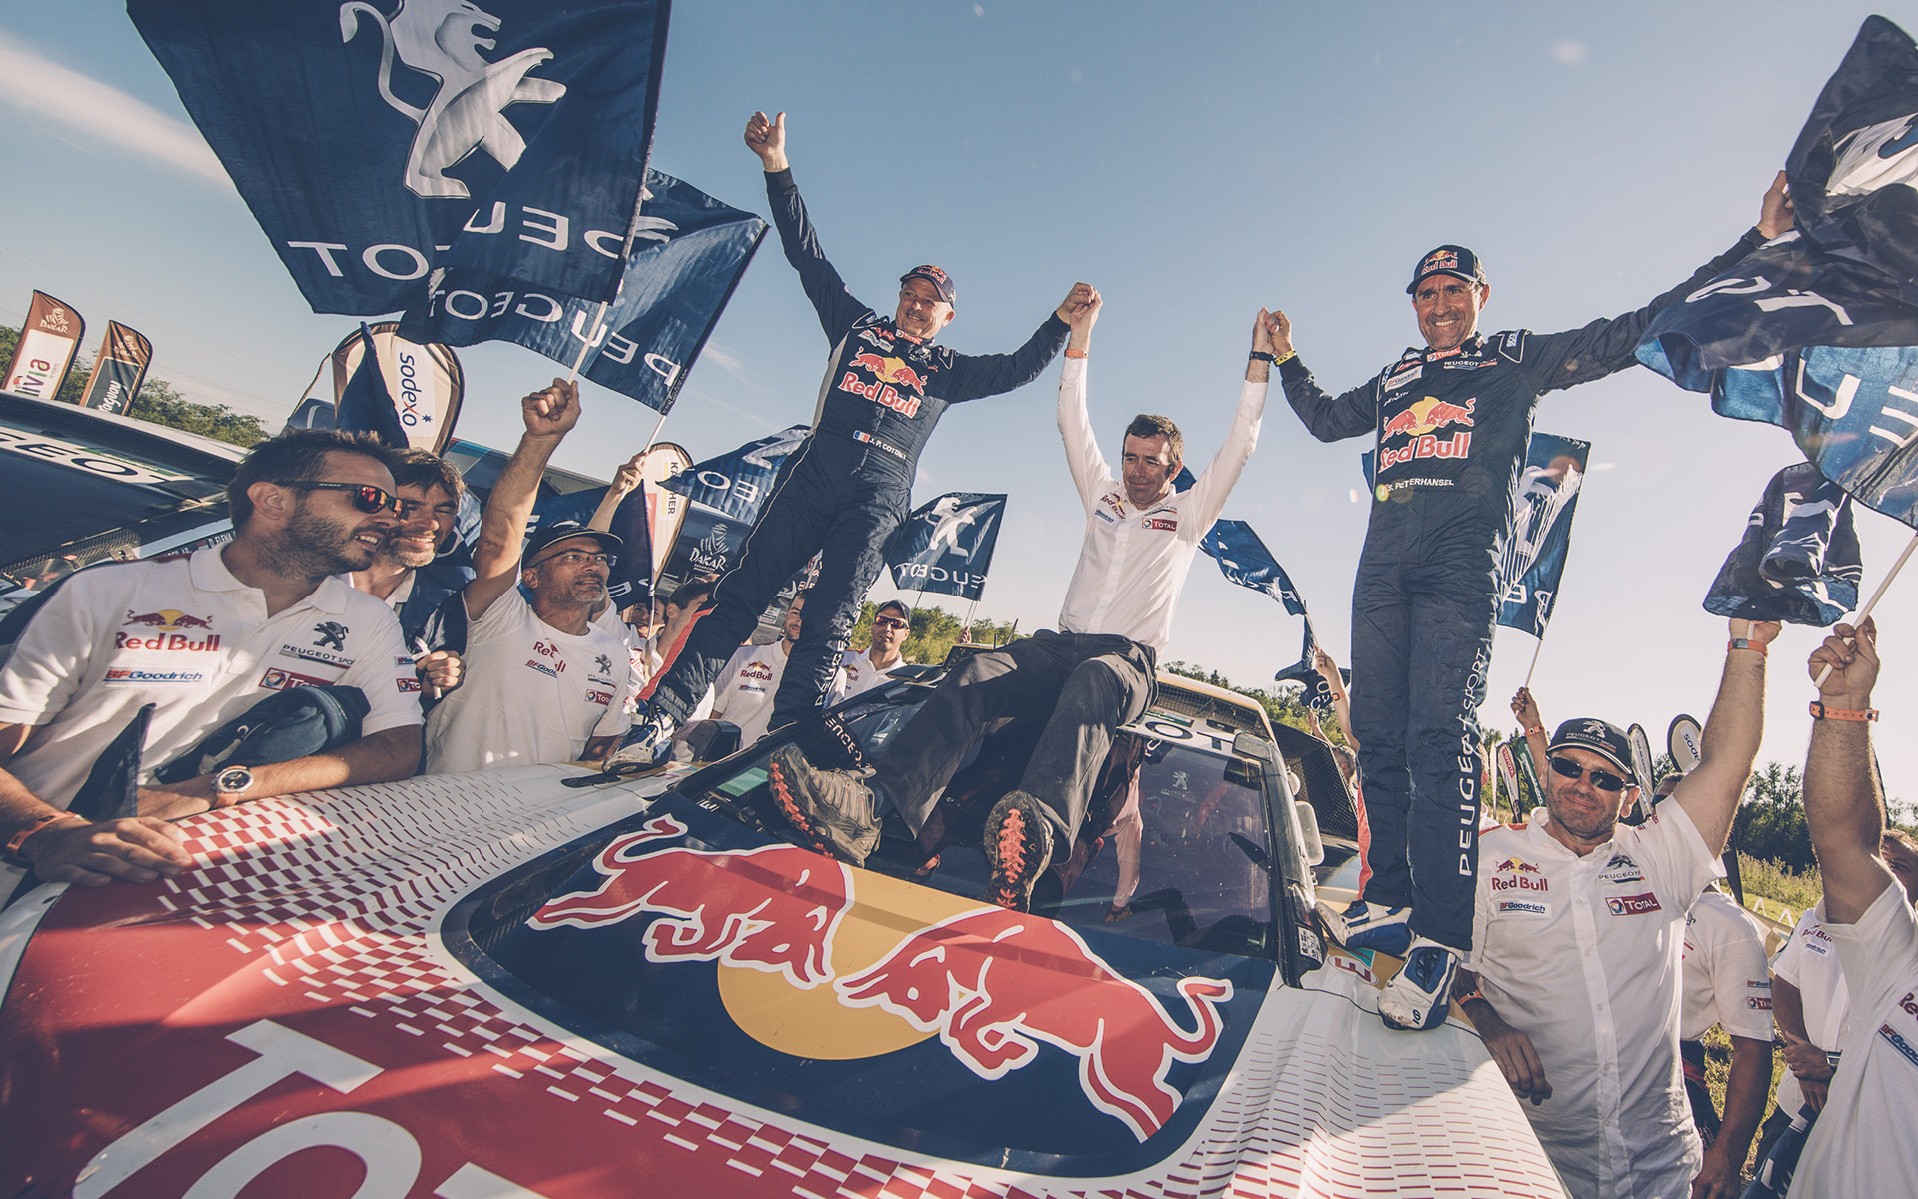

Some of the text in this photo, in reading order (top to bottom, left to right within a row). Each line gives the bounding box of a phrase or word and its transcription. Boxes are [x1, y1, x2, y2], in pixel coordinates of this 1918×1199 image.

[1421, 260, 1458, 275] Red Bull
[400, 352, 422, 427] sodexo
[838, 371, 922, 419] Red Bull
[1378, 431, 1472, 474] Red Bull
[1394, 478, 1455, 491] PETERHANSEL
[1154, 520, 1176, 530] TOTAL
[689, 547, 727, 572] DAKAR
[115, 631, 221, 652] Red Bull
[282, 644, 337, 661] PEUGEOT
[104, 669, 203, 681] BFGoodrich
[740, 669, 773, 681] Red Bull
[1566, 732, 1600, 741] PEUGEOT
[1501, 748, 1516, 778] TOYOTA
[1492, 875, 1549, 892] Red Bull
[1500, 901, 1546, 912] BFGoodrich
[1625, 900, 1658, 911] TOTAL
